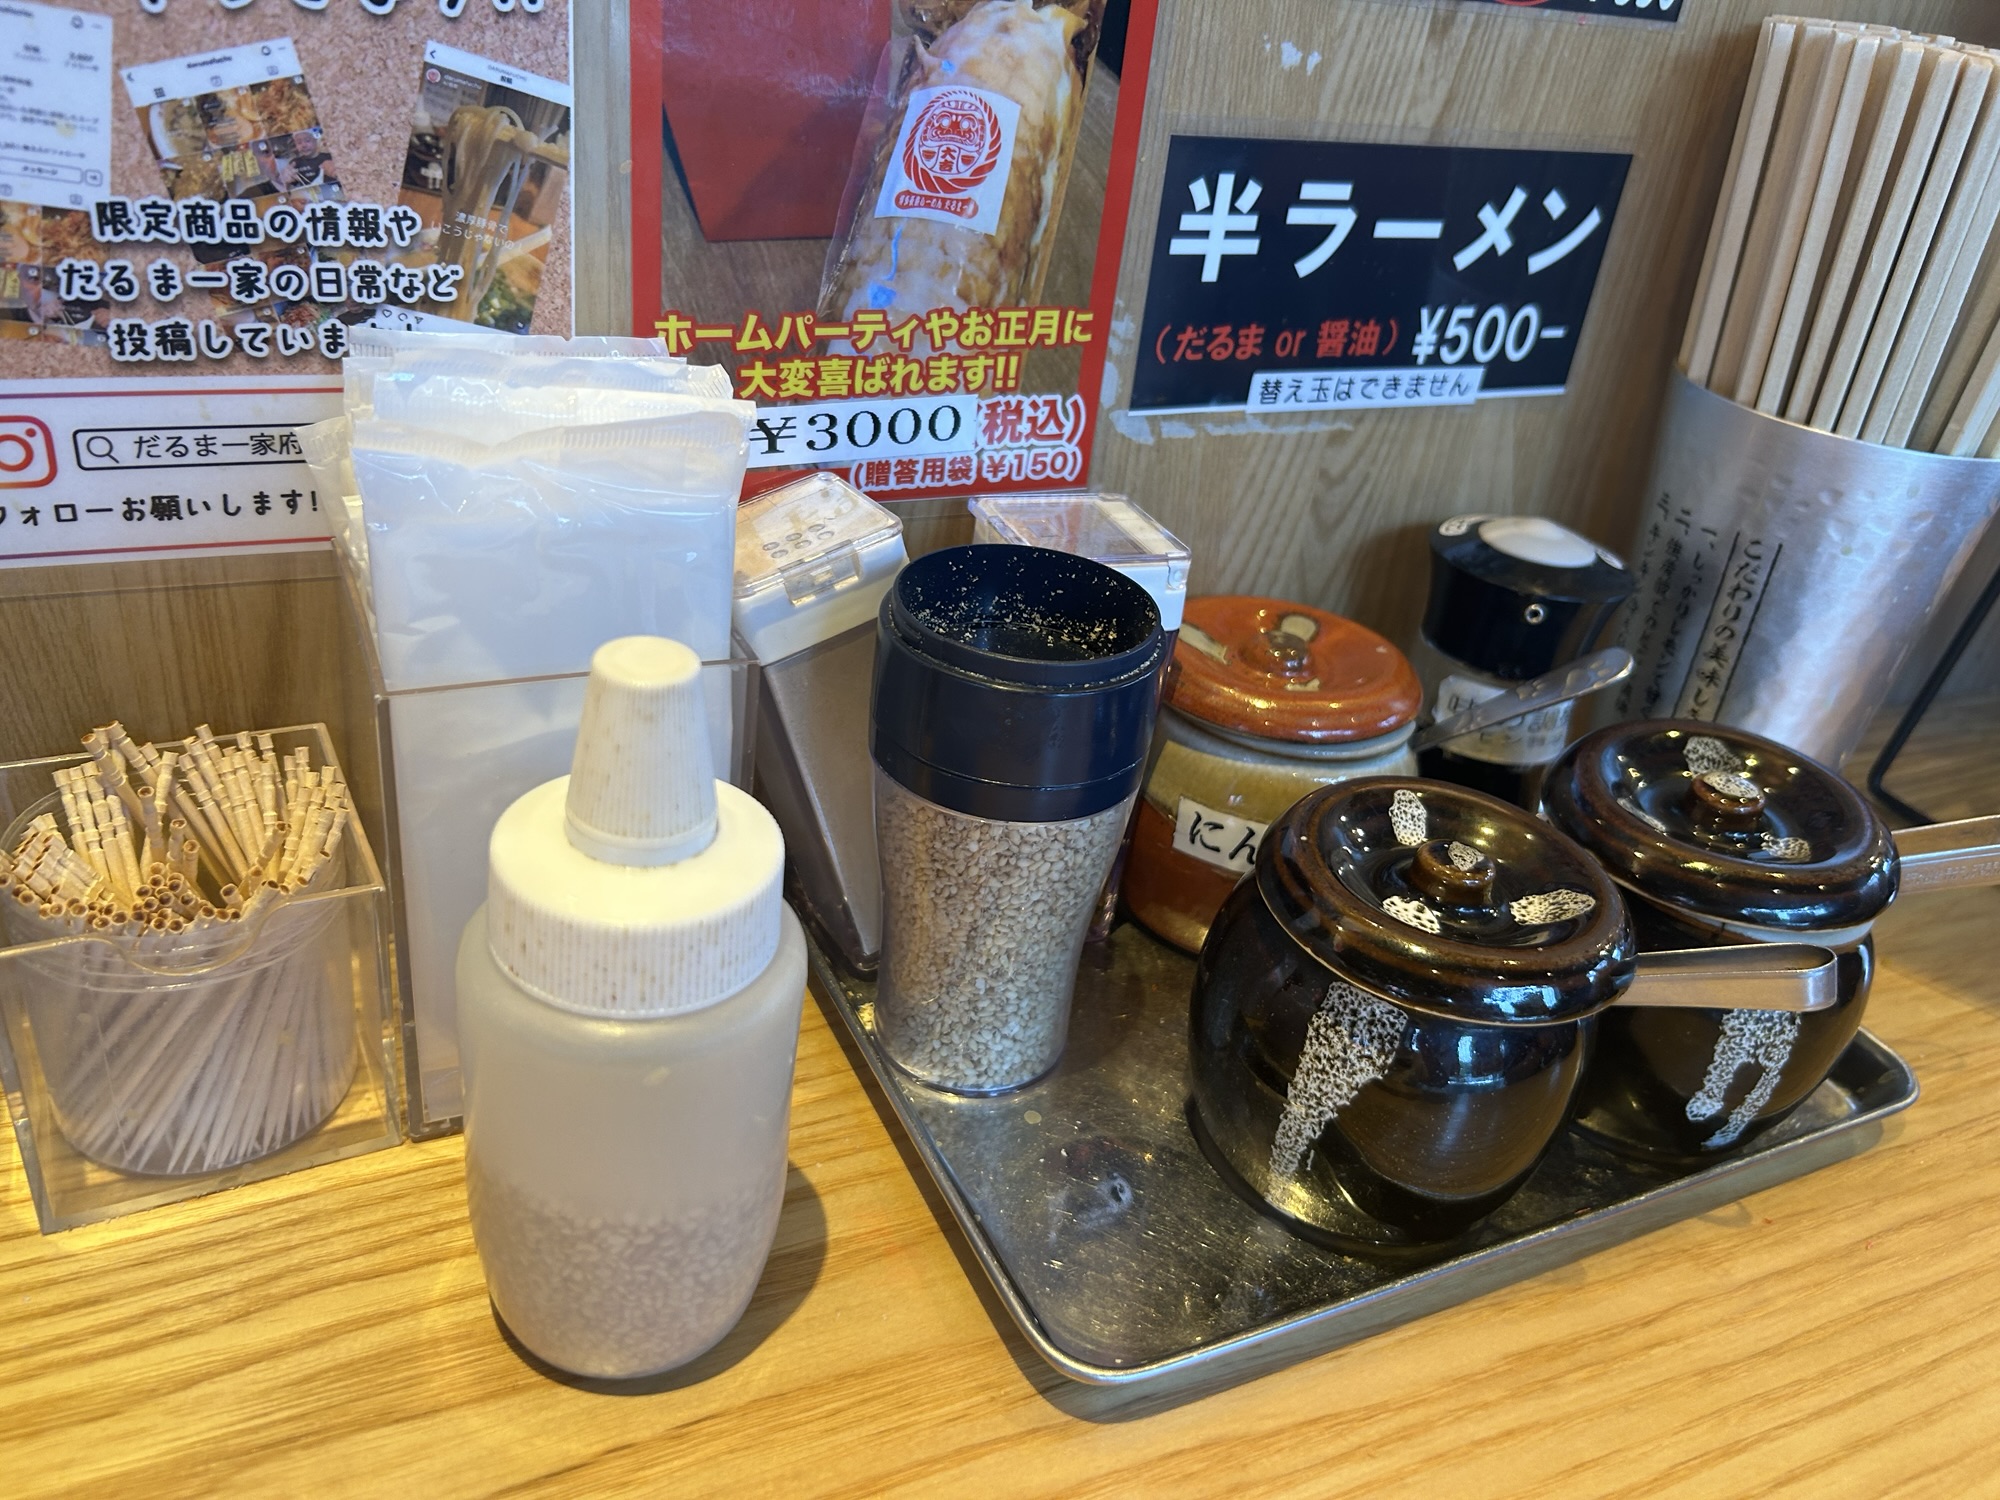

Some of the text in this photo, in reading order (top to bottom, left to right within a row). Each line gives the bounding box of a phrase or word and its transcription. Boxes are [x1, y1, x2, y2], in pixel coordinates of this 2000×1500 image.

[95, 200, 421, 245] 限定商品の情報や
[1168, 171, 1602, 284] 半ラーメン
[61, 263, 461, 300] だるま一家の日常など
[113, 320, 413, 357] 投稿していま
[654, 308, 1095, 353] ホームパーティやお正月に
[1275, 330, 1307, 358] or
[739, 353, 1019, 399] 大変喜ばれます!!
[1259, 372, 1470, 405] 替え玉はできません
[749, 404, 963, 455] ¥3000
[977, 398, 1086, 447] 税込)
